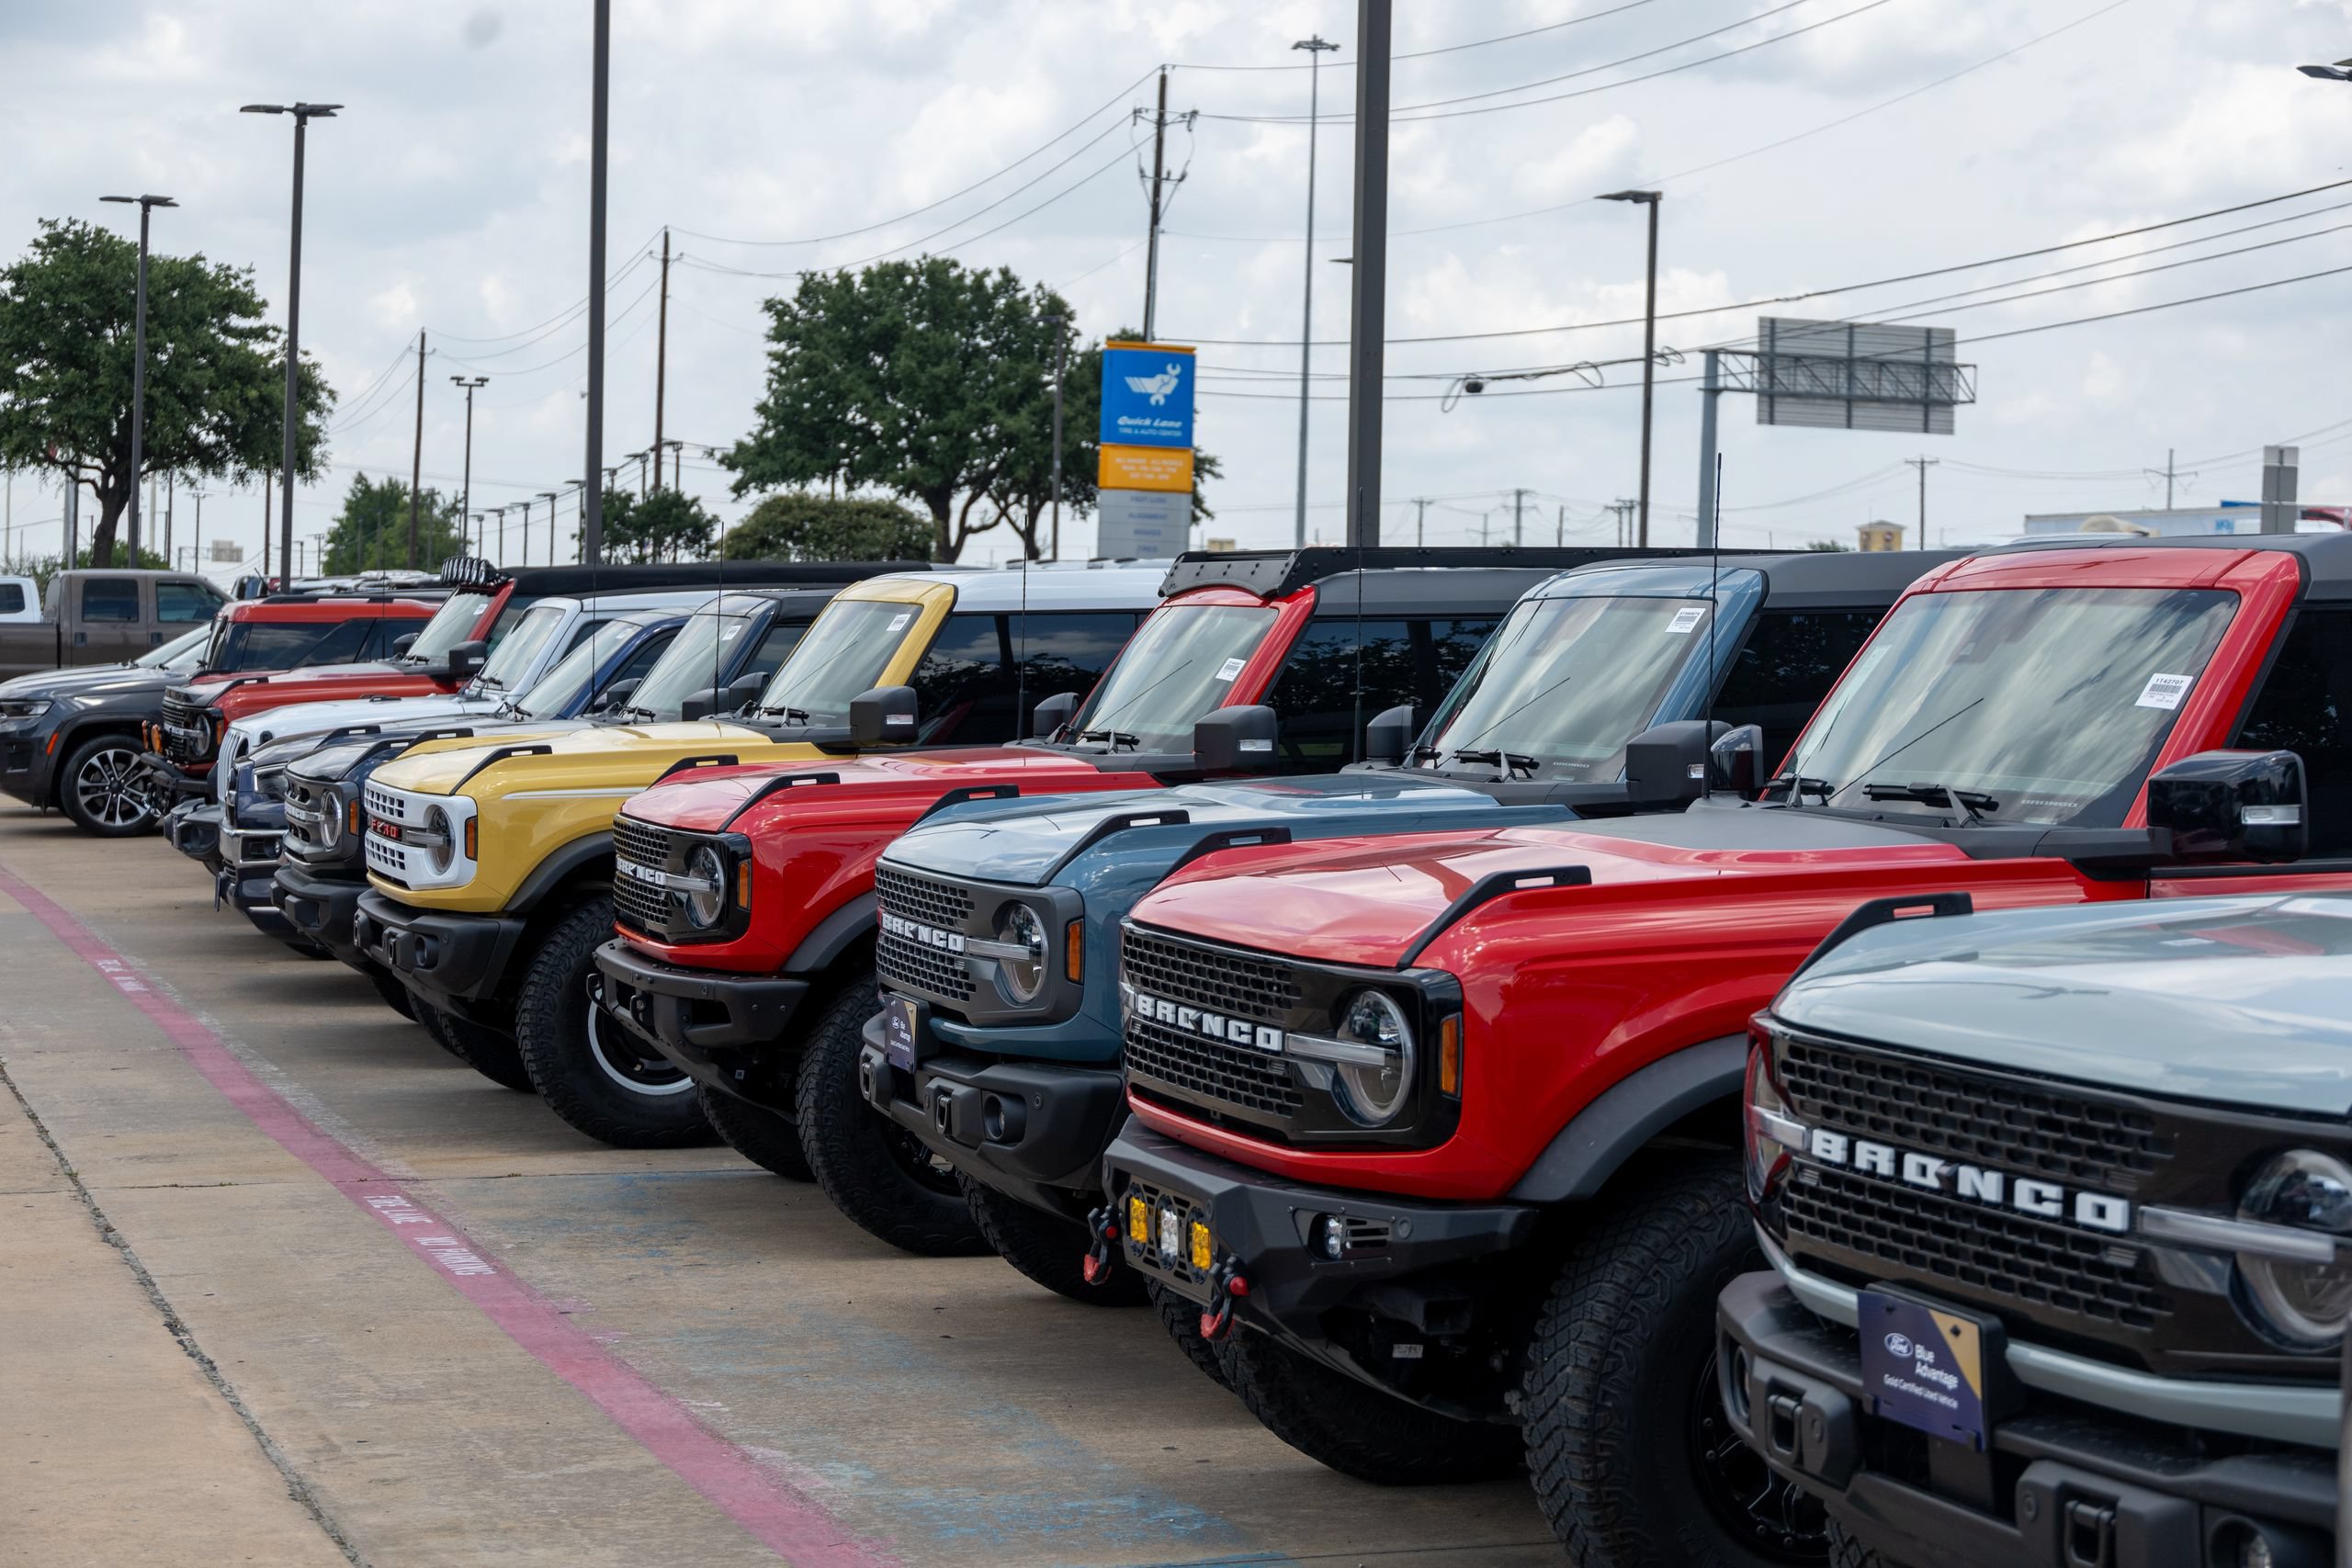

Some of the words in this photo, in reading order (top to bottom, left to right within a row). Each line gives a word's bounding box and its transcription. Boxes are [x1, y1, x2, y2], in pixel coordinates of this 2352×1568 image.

[1117, 415, 1151, 426] Quick
[1152, 417, 1182, 429] Lane
[2021, 799, 2078, 807] BRONCO
[882, 912, 965, 953] BRONCO
[1137, 993, 1283, 1052] BRONCO
[1811, 1127, 2129, 1232] BRONCO
[363, 1195, 413, 1208] FIRE
[380, 1209, 434, 1224] LANE
[413, 1236, 458, 1246] NO
[427, 1247, 497, 1276] PARKING
[1915, 1344, 1935, 1363] Blue
[1915, 1361, 1959, 1391] Advantage
